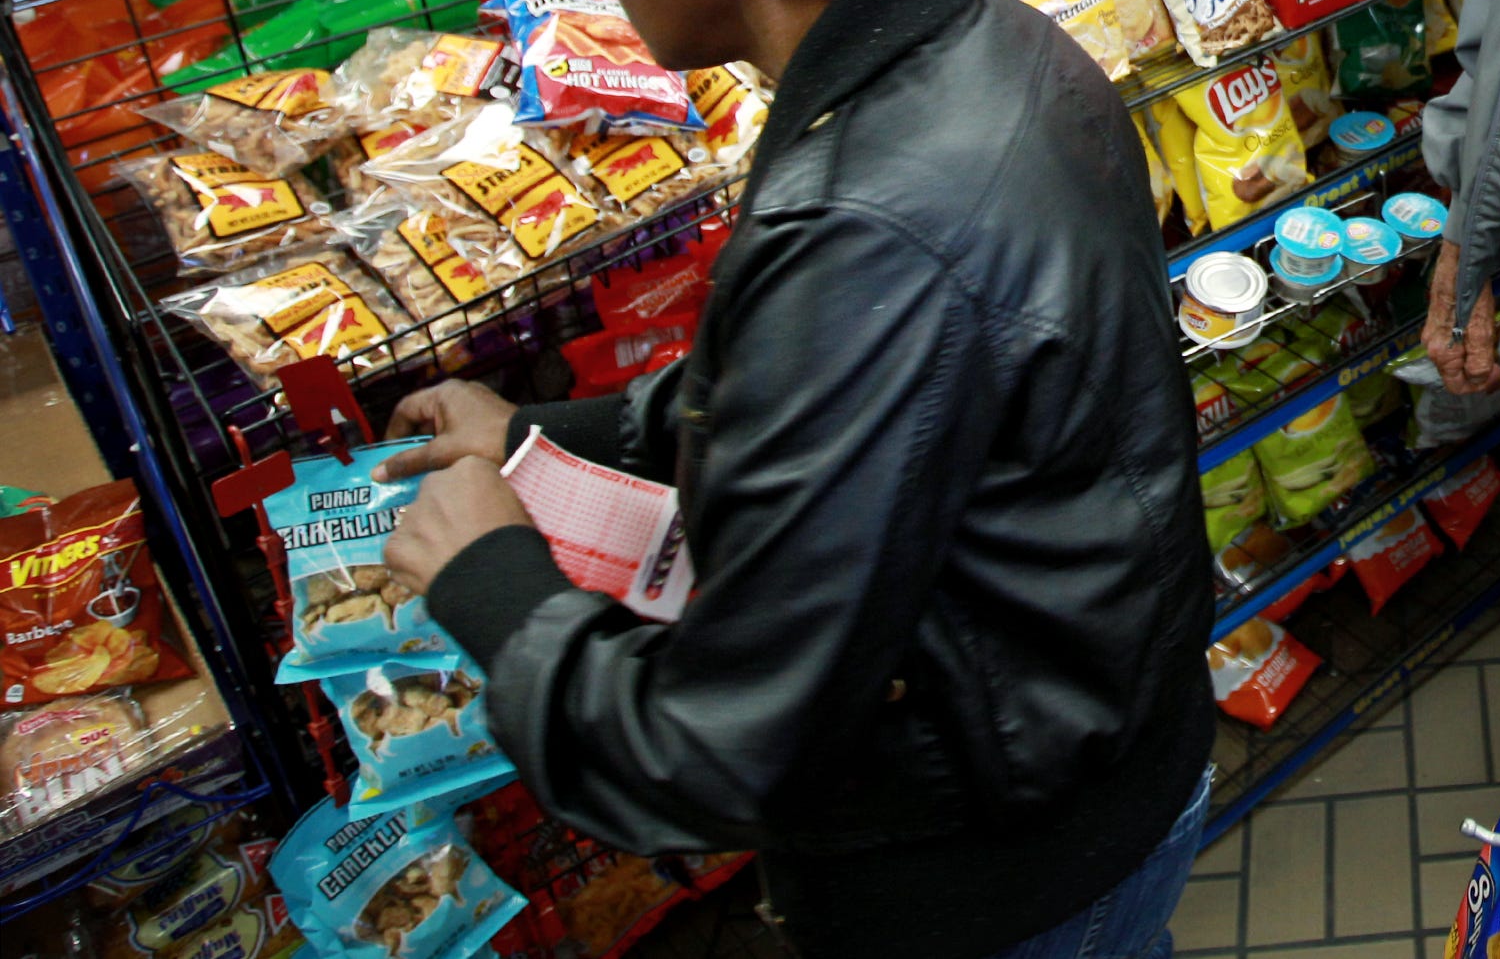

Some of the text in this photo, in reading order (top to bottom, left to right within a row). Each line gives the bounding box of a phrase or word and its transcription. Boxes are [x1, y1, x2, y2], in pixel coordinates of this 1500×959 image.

[566, 72, 599, 88] HOT
[1212, 57, 1278, 124] Lays
[1243, 118, 1293, 153] Classic
[1304, 175, 1361, 209] Great
[1338, 348, 1390, 387] Great
[310, 486, 372, 512] PORKIE
[1400, 467, 1446, 505] Great
[317, 811, 409, 900] CRACKLI
